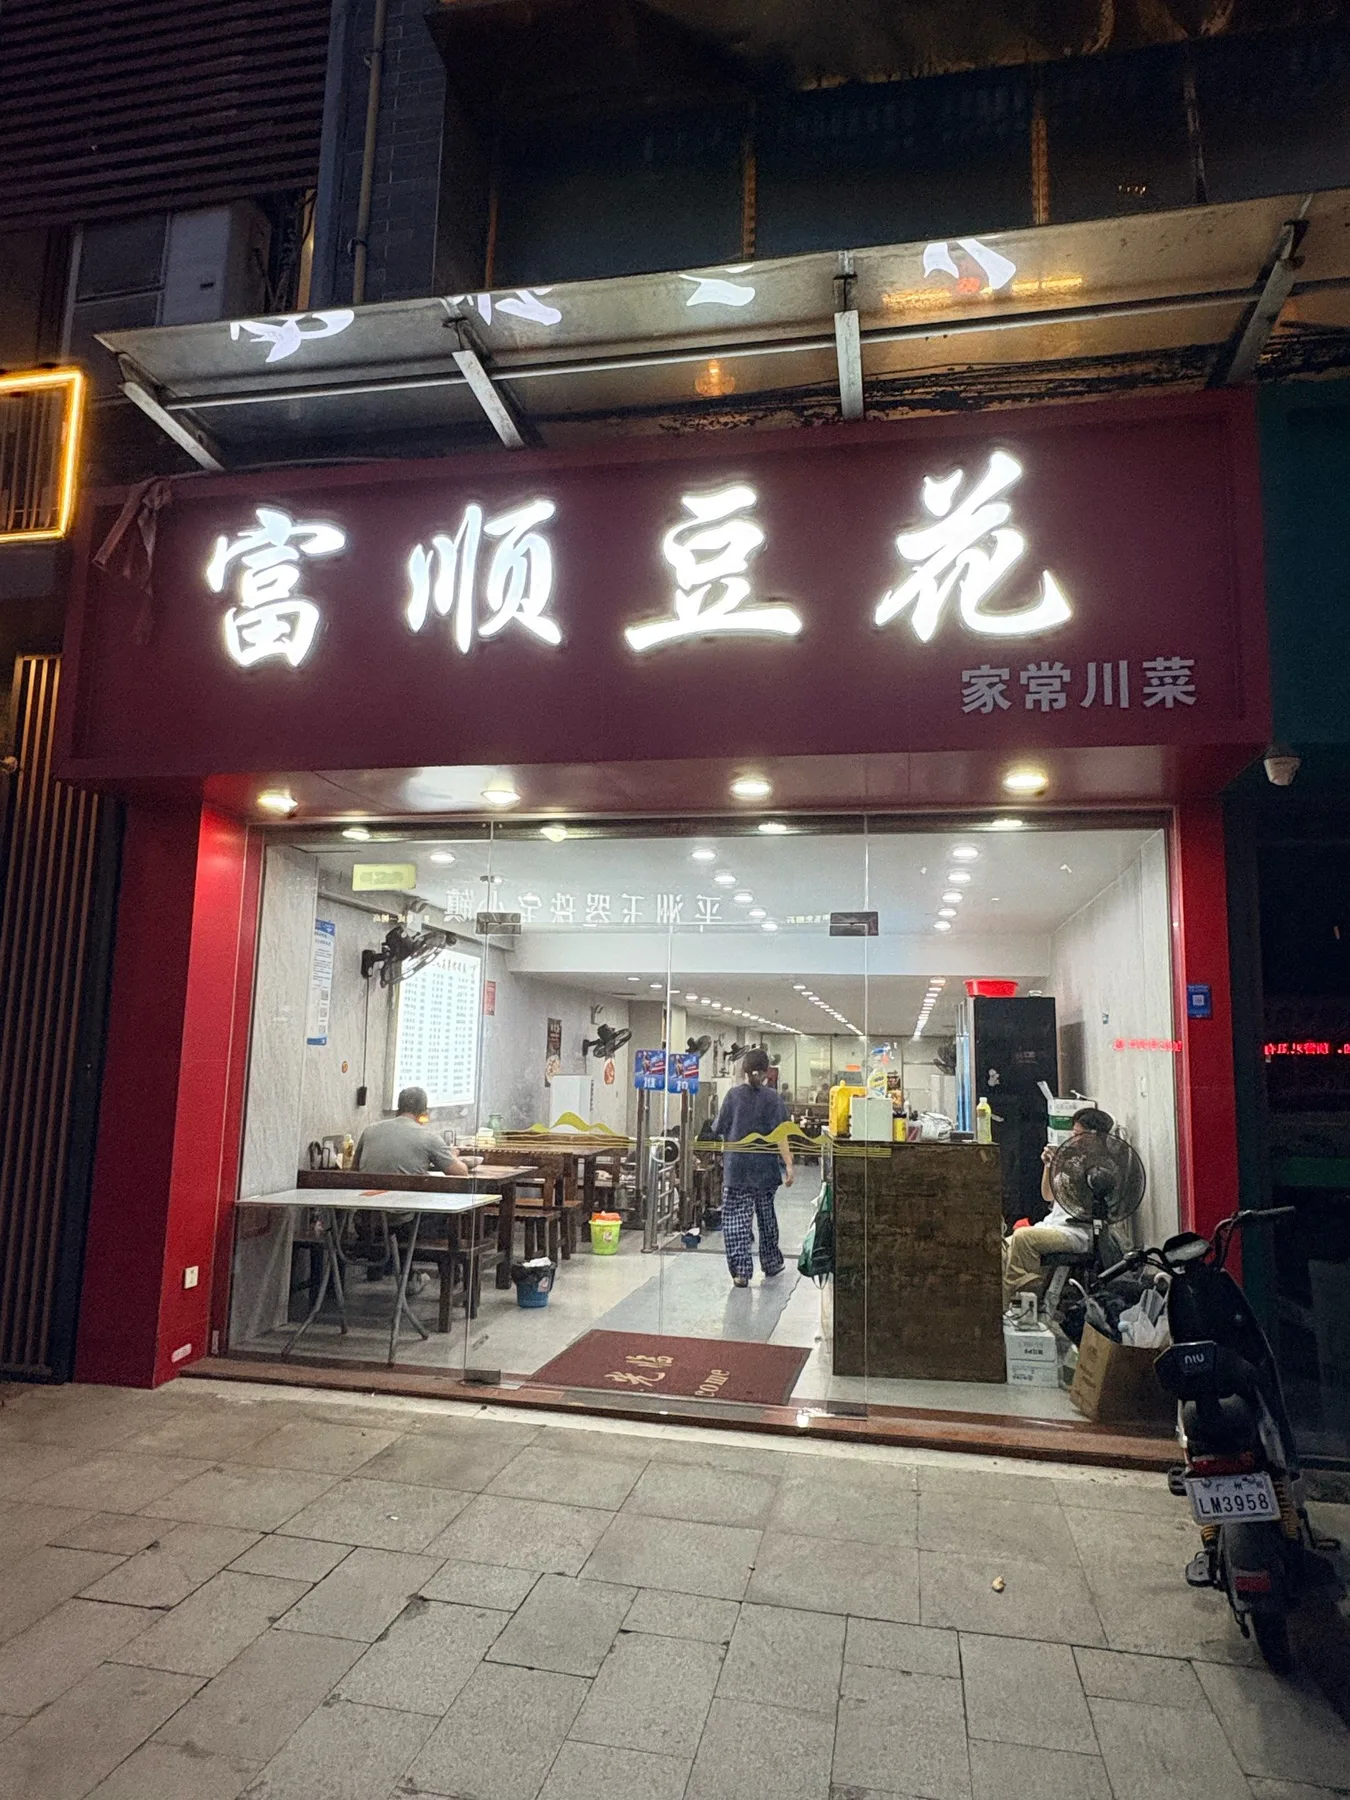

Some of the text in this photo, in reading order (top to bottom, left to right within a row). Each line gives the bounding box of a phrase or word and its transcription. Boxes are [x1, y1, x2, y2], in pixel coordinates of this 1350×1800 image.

[204, 447, 1075, 669] 富顺豆花
[960, 655, 1198, 713] 家常川菜
[1198, 1492, 1269, 1515] LM3958
